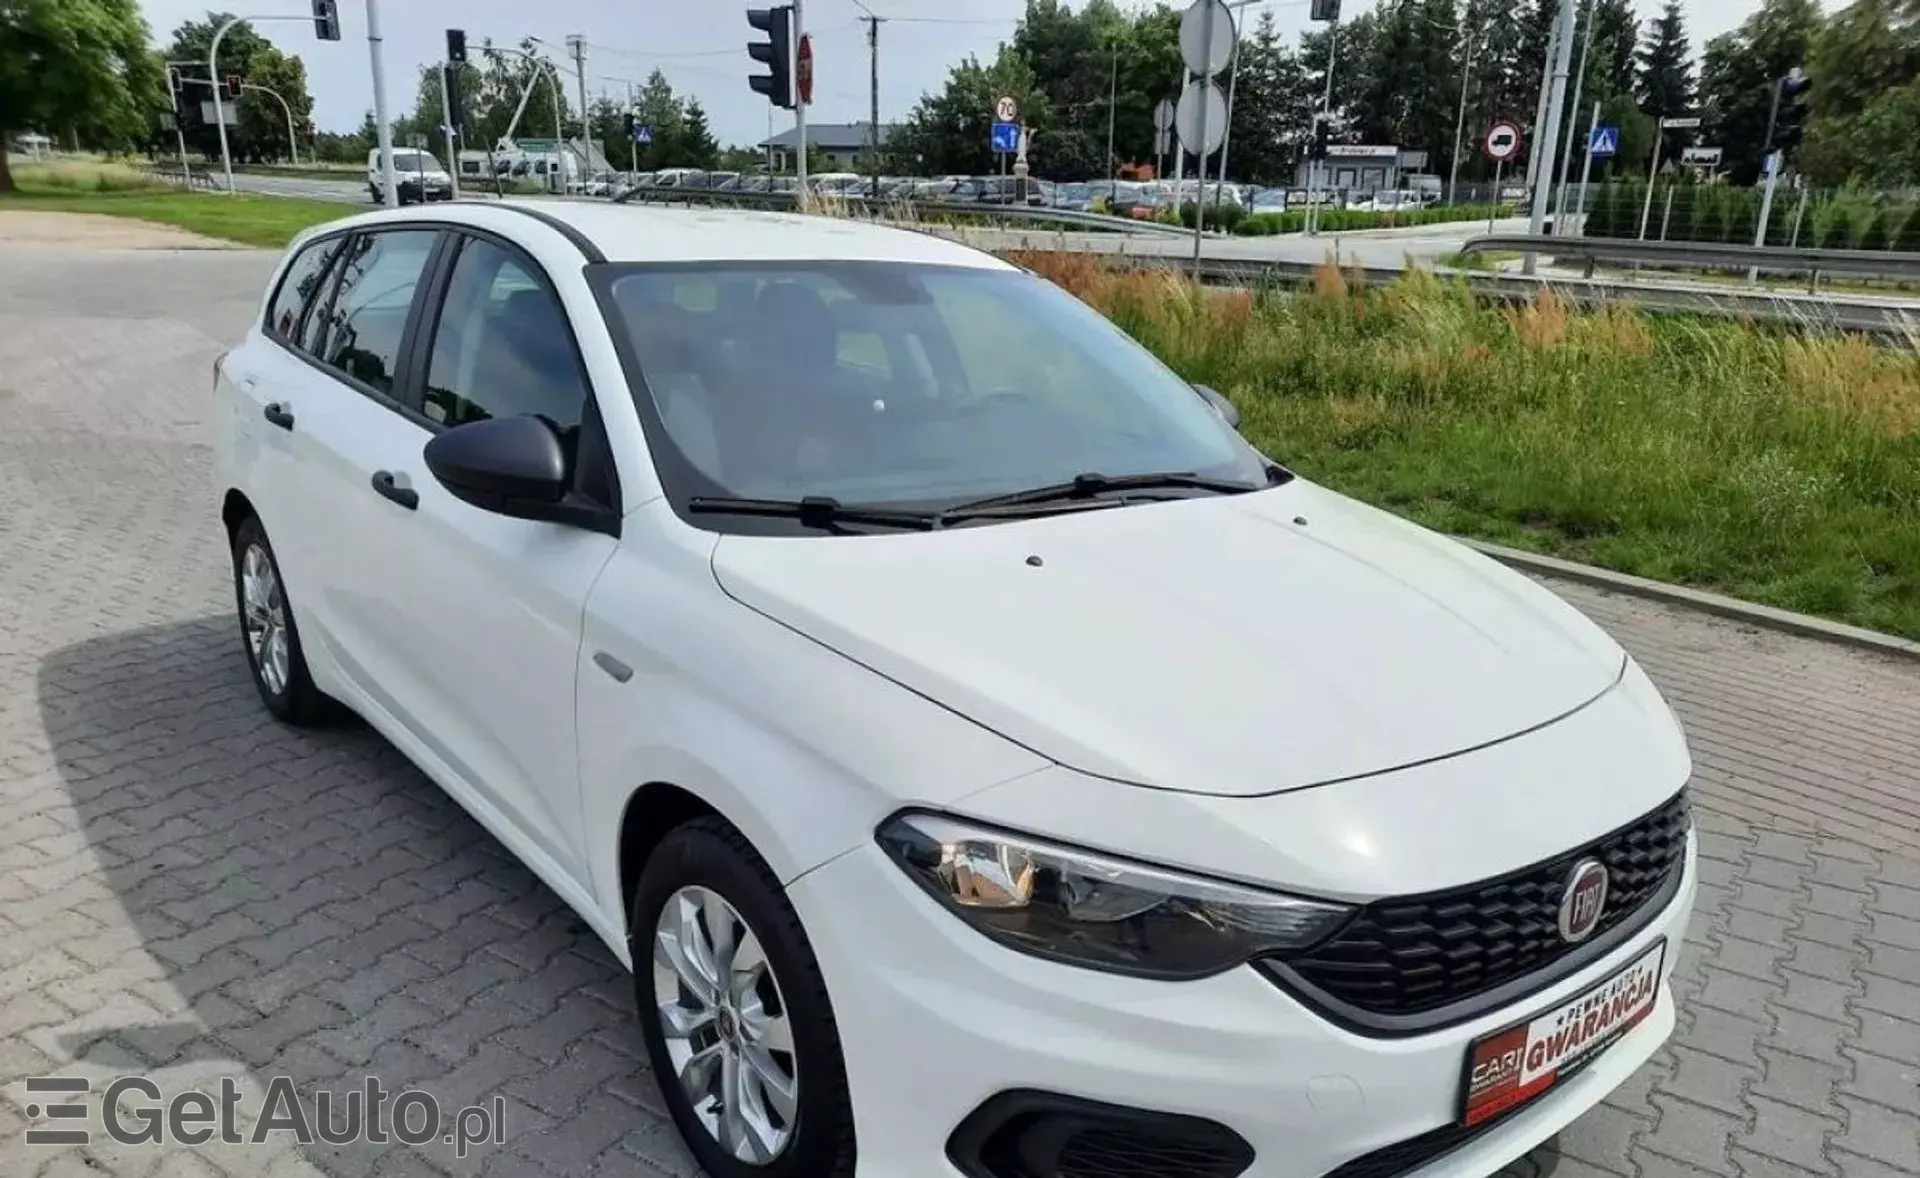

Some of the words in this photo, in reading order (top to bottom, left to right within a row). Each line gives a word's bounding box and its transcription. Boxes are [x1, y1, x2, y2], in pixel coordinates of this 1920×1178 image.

[1000, 101, 1013, 117] 70
[1572, 883, 1601, 925] FIAT
[1526, 970, 1653, 1072] GWARANCJA
